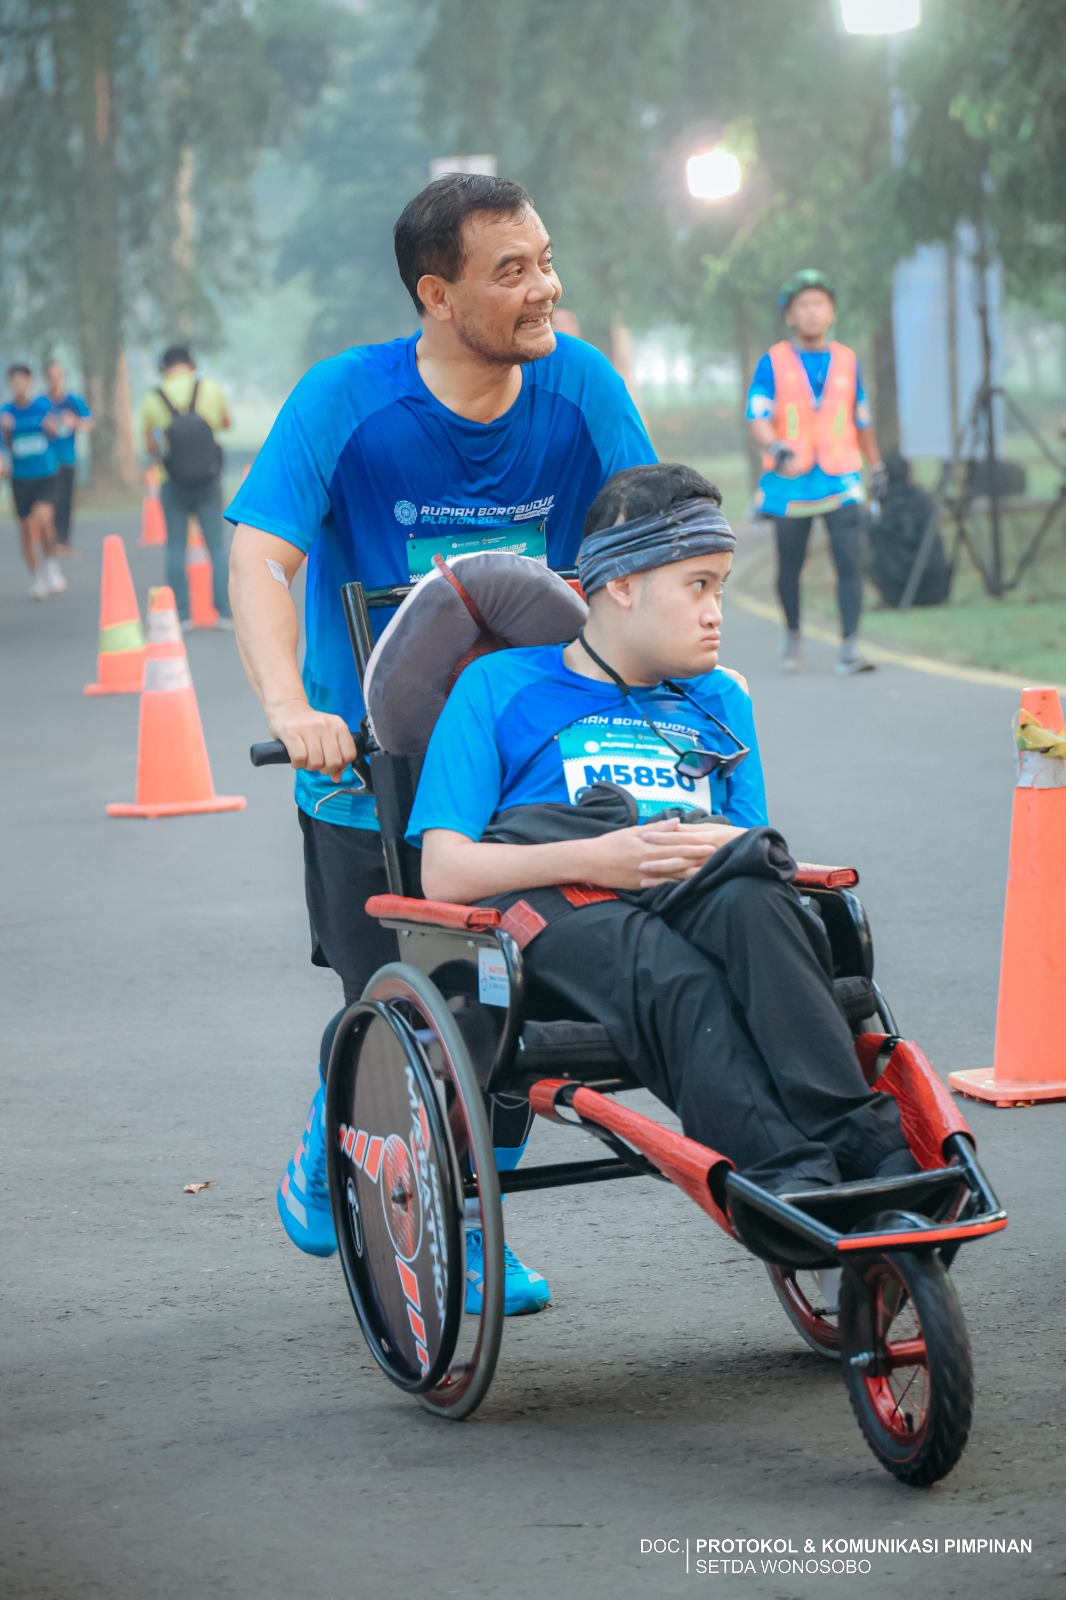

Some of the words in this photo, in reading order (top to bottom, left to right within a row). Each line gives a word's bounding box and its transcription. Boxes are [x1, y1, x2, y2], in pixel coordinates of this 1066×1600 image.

[420, 506, 476, 517] RUPIAH
[477, 495, 555, 517] BOROBUDUR
[421, 515, 475, 525] PLAYON
